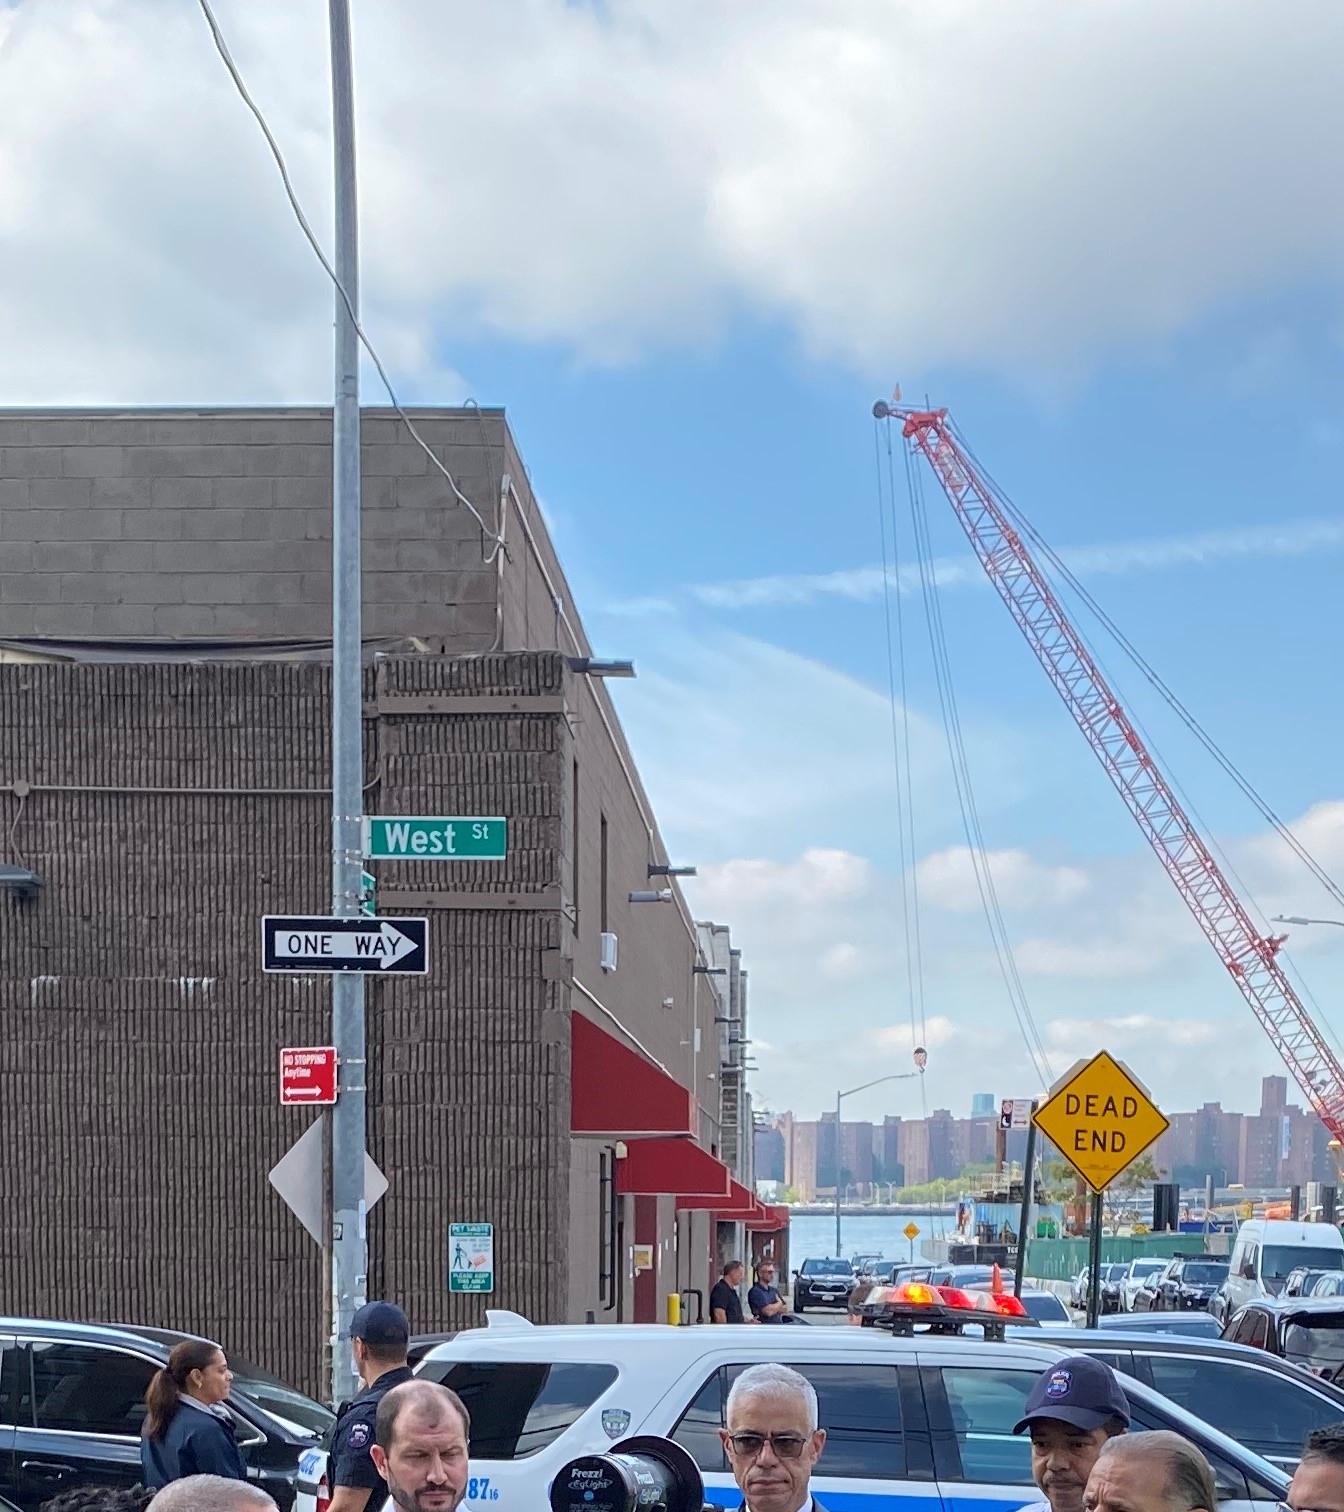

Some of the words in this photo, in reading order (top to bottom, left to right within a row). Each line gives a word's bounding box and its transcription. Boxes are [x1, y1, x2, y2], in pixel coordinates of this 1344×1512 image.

[385, 823, 456, 853] West
[472, 824, 489, 840] St
[288, 935, 333, 955] ONE
[356, 936, 402, 955] WAY
[284, 1054, 294, 1065] NO
[295, 1053, 326, 1065] STOPPING
[285, 1067, 311, 1080] Anytime
[1065, 1093, 1138, 1118] DEAD
[1074, 1129, 1126, 1153] END
[467, 1478, 490, 1499] 87
